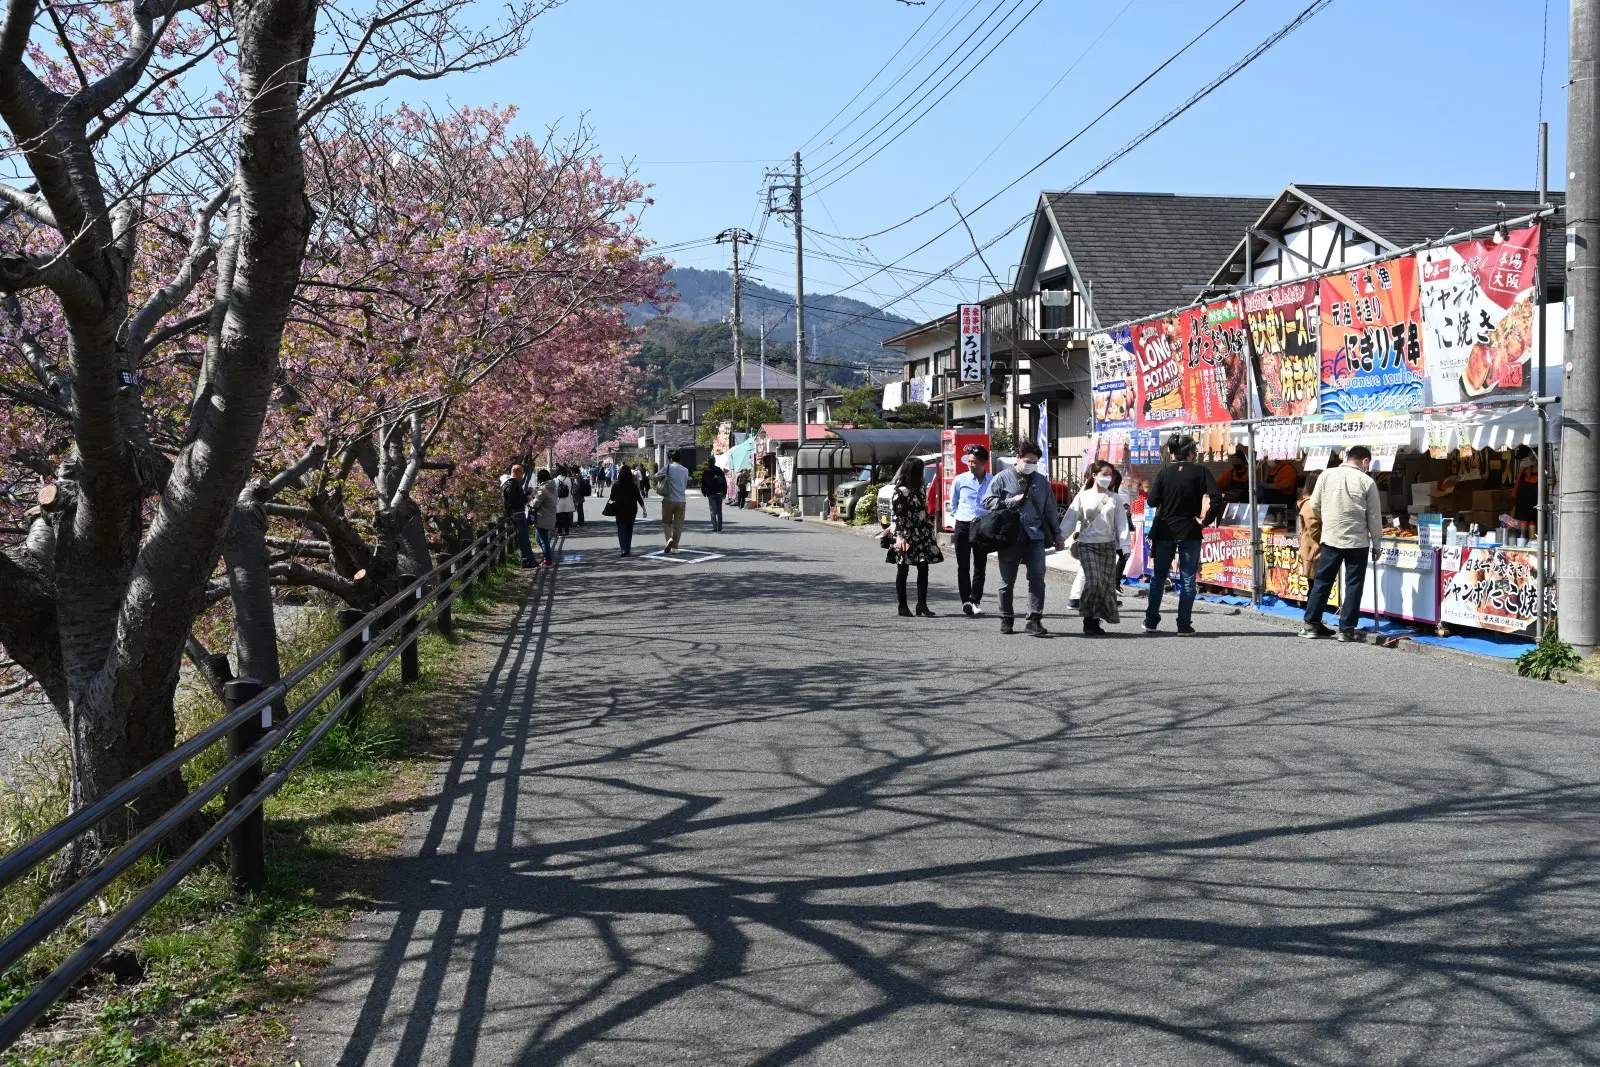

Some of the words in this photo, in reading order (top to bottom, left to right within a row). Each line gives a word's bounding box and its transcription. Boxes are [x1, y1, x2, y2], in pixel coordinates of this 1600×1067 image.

[1499, 251, 1523, 270] 本場
[1492, 271, 1520, 289] 大阪
[972, 307, 980, 334] 食事処
[963, 335, 979, 379] ろばた
[1137, 333, 1171, 372] LONG
[1344, 320, 1421, 373] にぎり天串
[1143, 359, 1178, 391] POTATO
[1330, 374, 1380, 391] Japanese
[1200, 541, 1225, 562] LONG
[1226, 546, 1252, 559] POTAT
[1442, 547, 1460, 559] ビール
